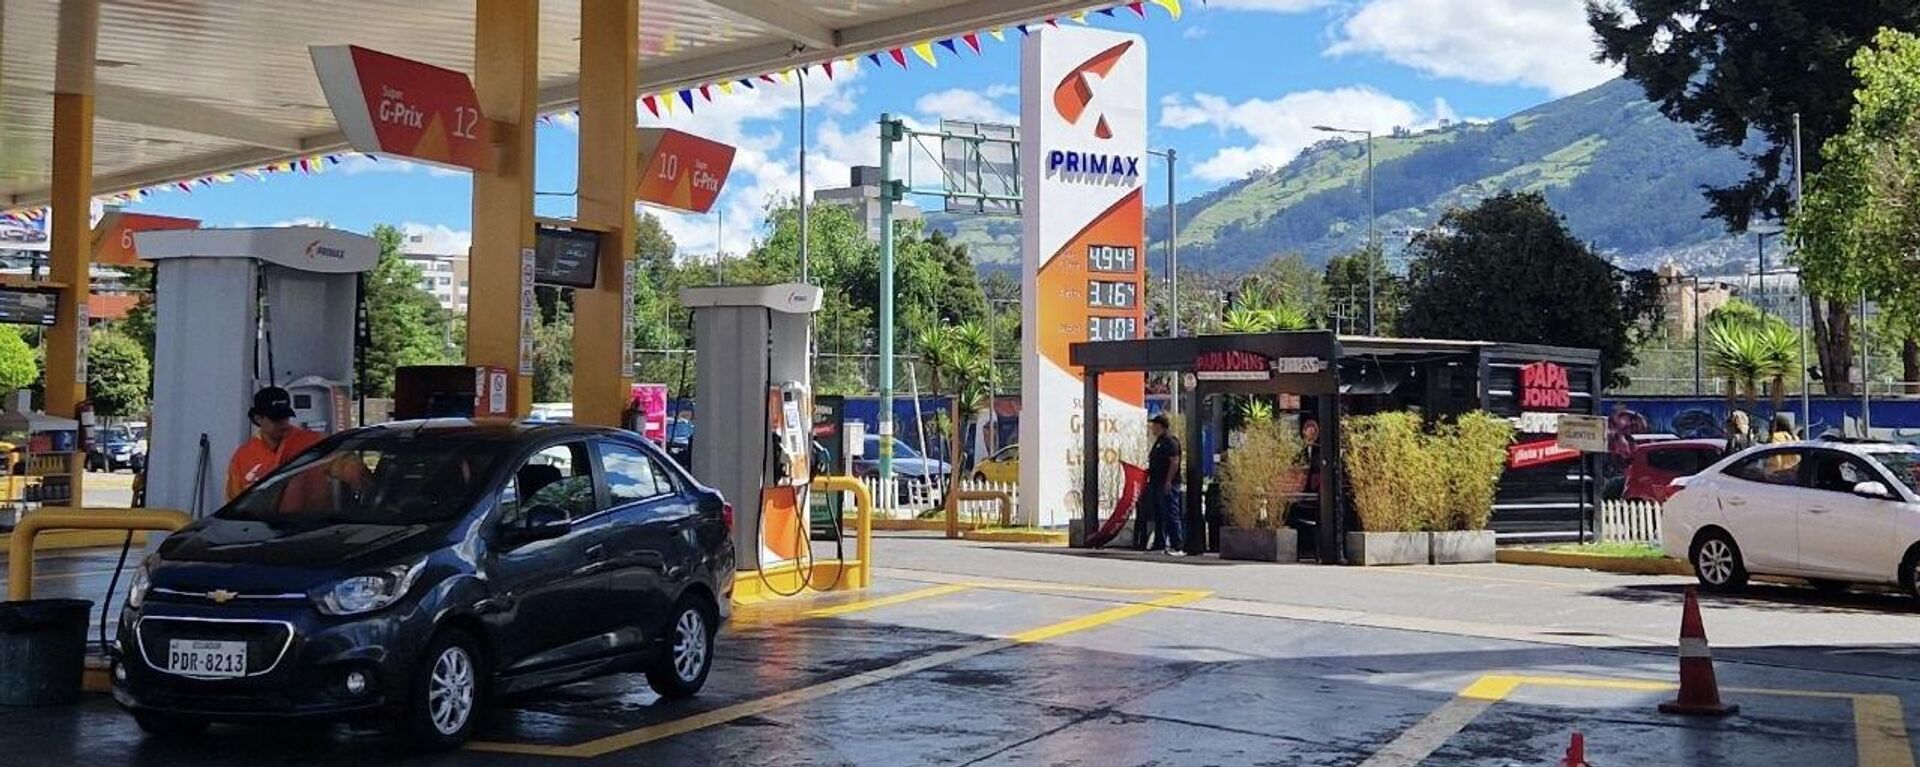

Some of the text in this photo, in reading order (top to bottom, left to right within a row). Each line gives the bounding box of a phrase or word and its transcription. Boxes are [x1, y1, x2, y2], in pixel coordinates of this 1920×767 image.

[379, 100, 424, 129] G-Prix
[451, 106, 478, 140] 12
[658, 152, 677, 180] 10
[1050, 150, 1139, 177] PRIMAX
[693, 170, 719, 192] G-Prix
[121, 228, 134, 249] 6
[1524, 362, 1569, 388] PAPA
[1523, 388, 1570, 407] JOHNS
[172, 652, 243, 672] PDR-8213
